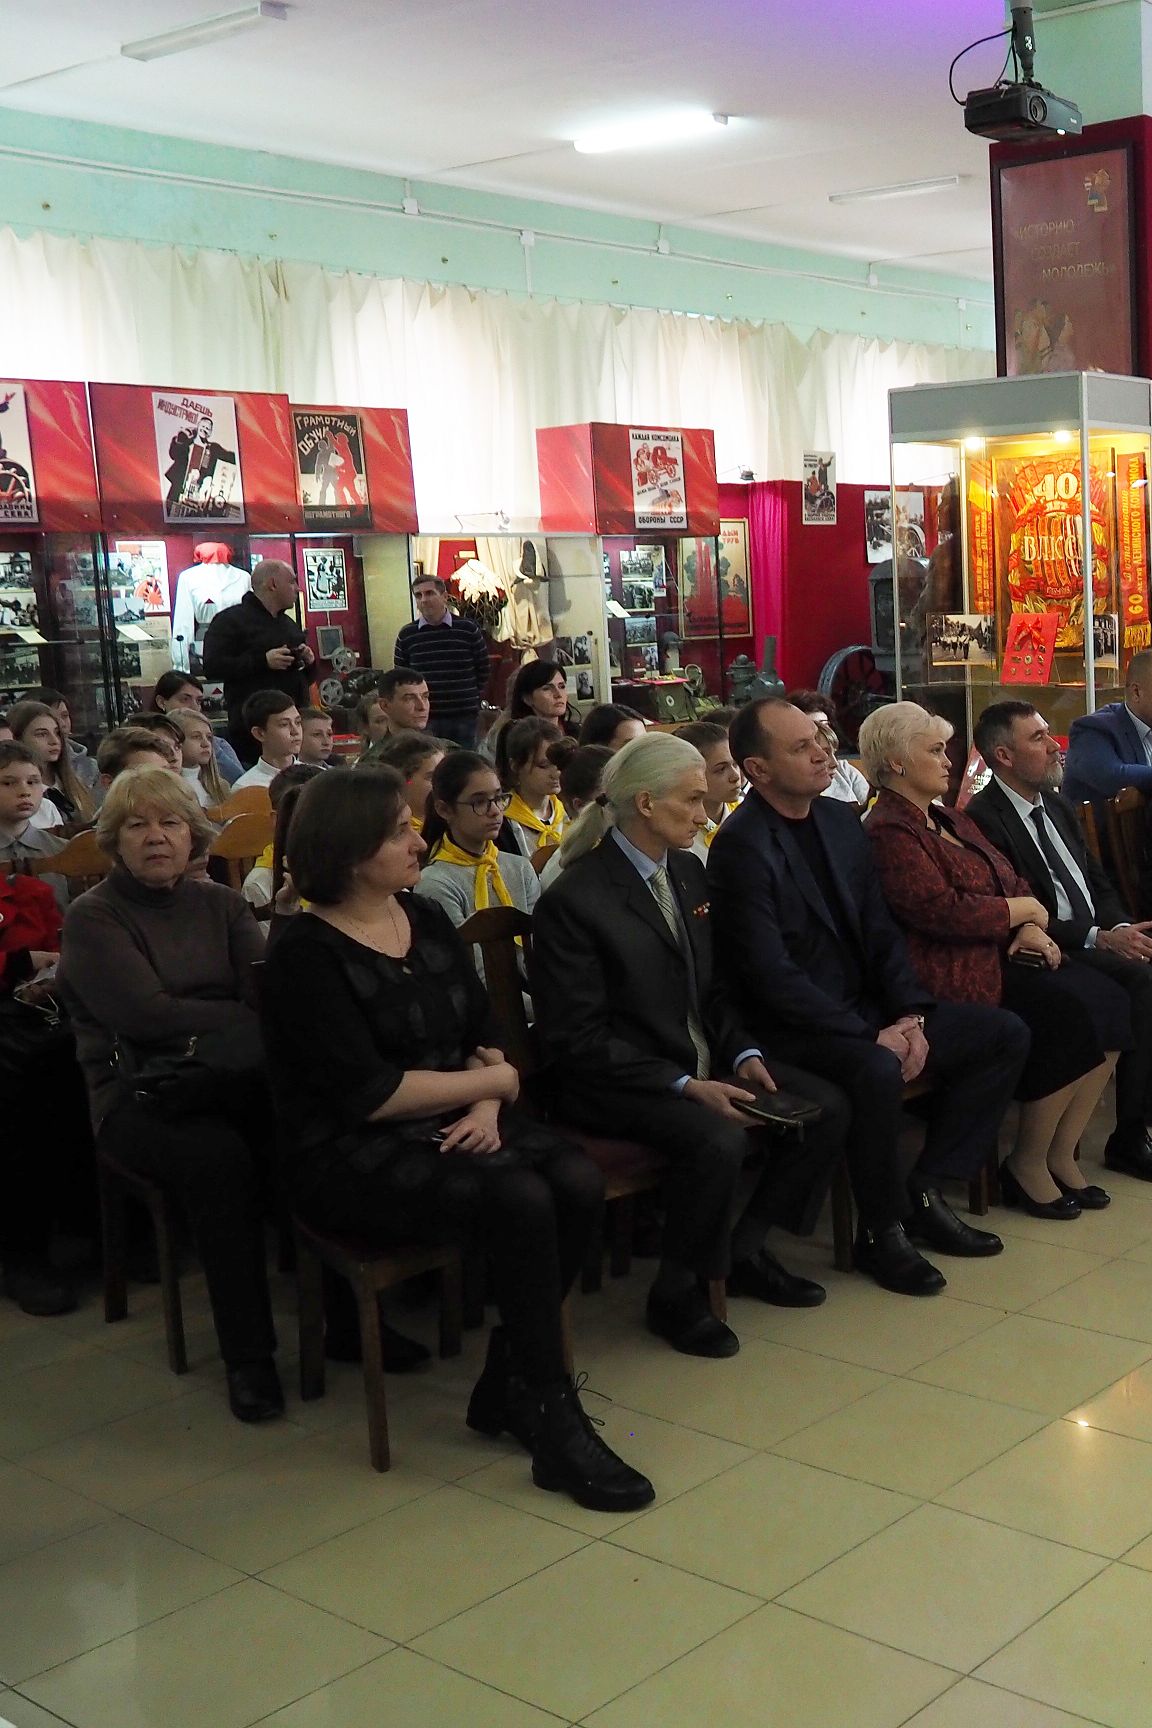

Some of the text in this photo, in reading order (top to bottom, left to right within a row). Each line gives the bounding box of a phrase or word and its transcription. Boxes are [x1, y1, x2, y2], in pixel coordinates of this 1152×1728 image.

[295, 415, 357, 437] ГРАМОТНЫЙ
[1032, 472, 1079, 501] 40
[638, 515, 684, 524] ОБОРОНЫ СССР
